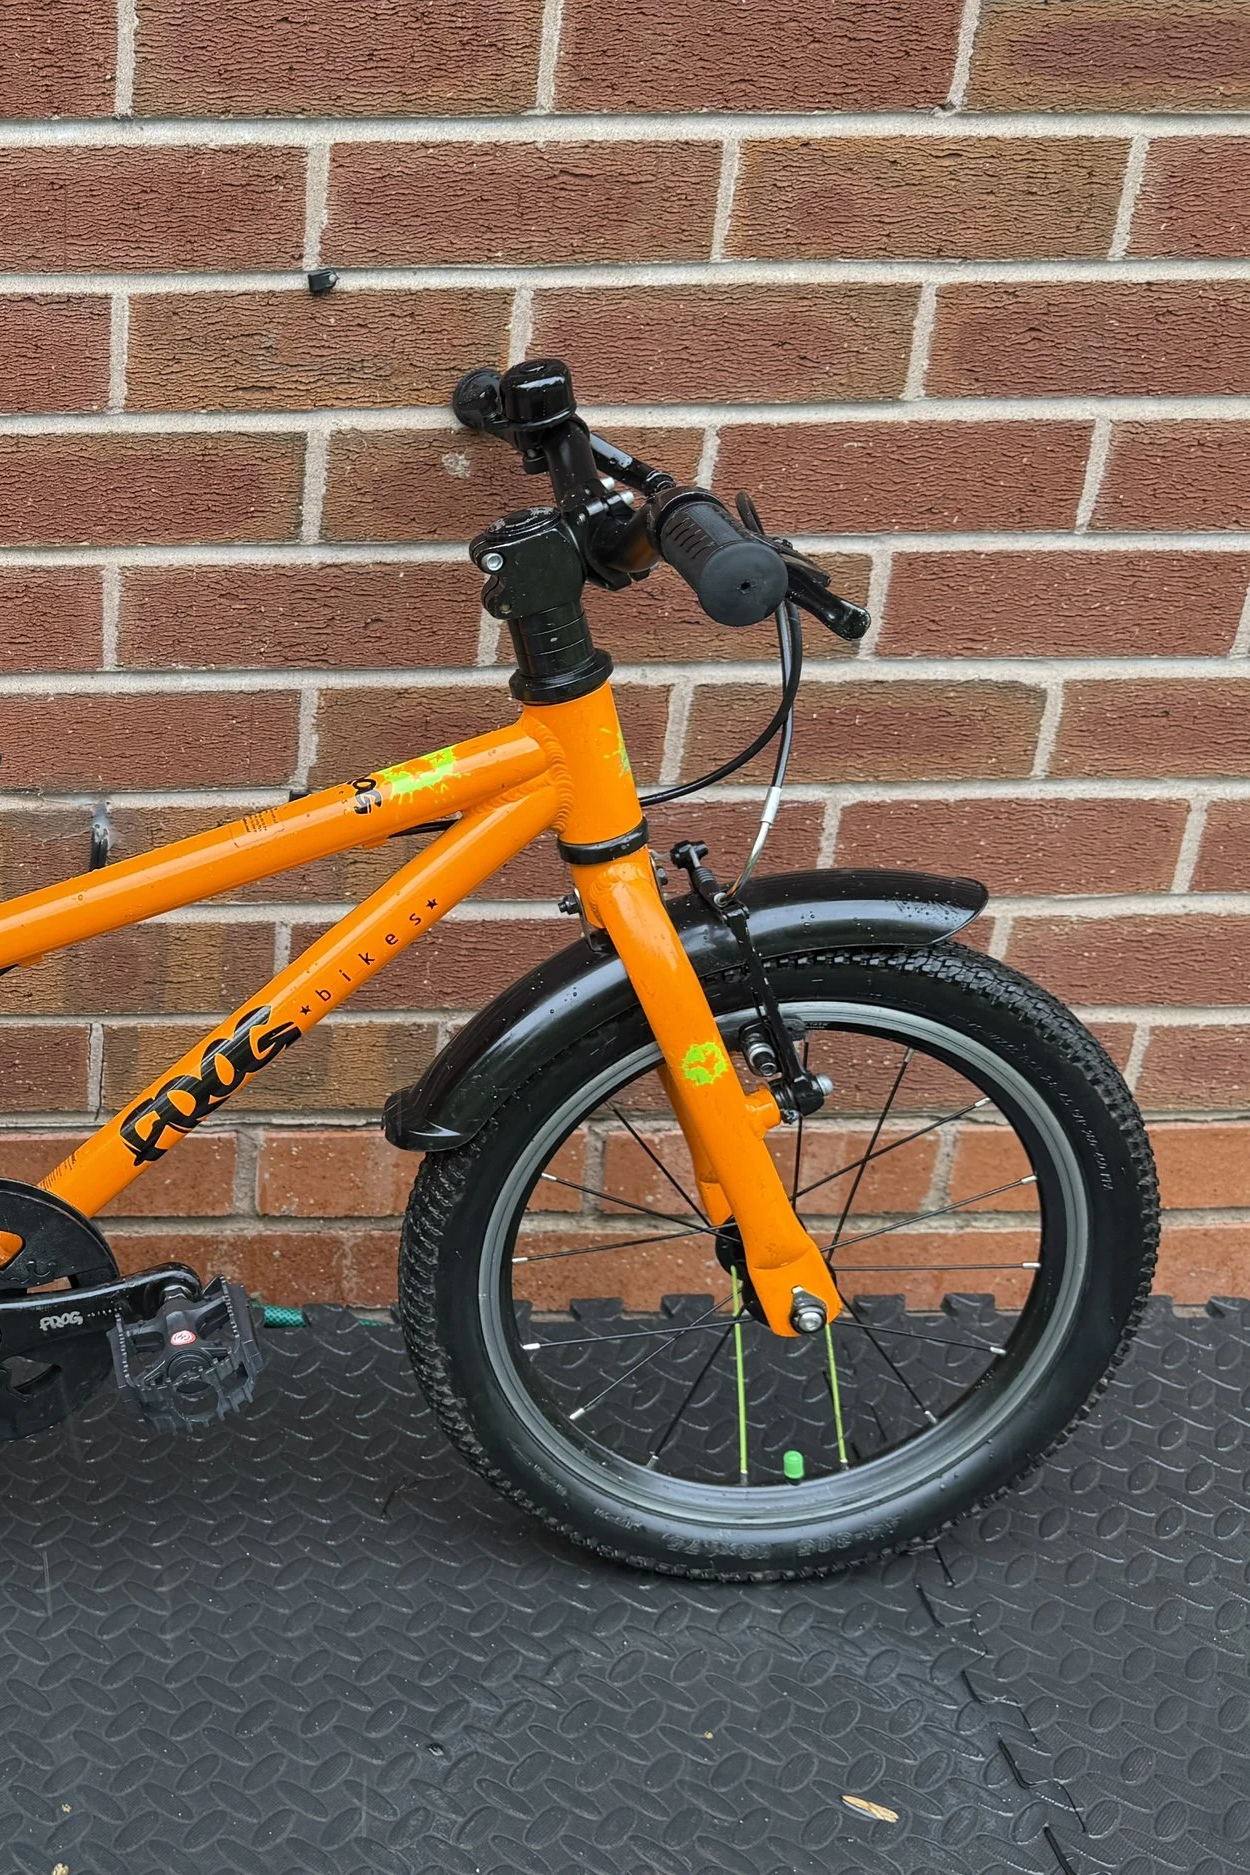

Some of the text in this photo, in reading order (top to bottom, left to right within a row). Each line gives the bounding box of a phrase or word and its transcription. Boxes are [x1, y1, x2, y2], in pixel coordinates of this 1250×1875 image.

[119, 912, 423, 1166] FROG bikes
[39, 1310, 84, 1332] FROG
